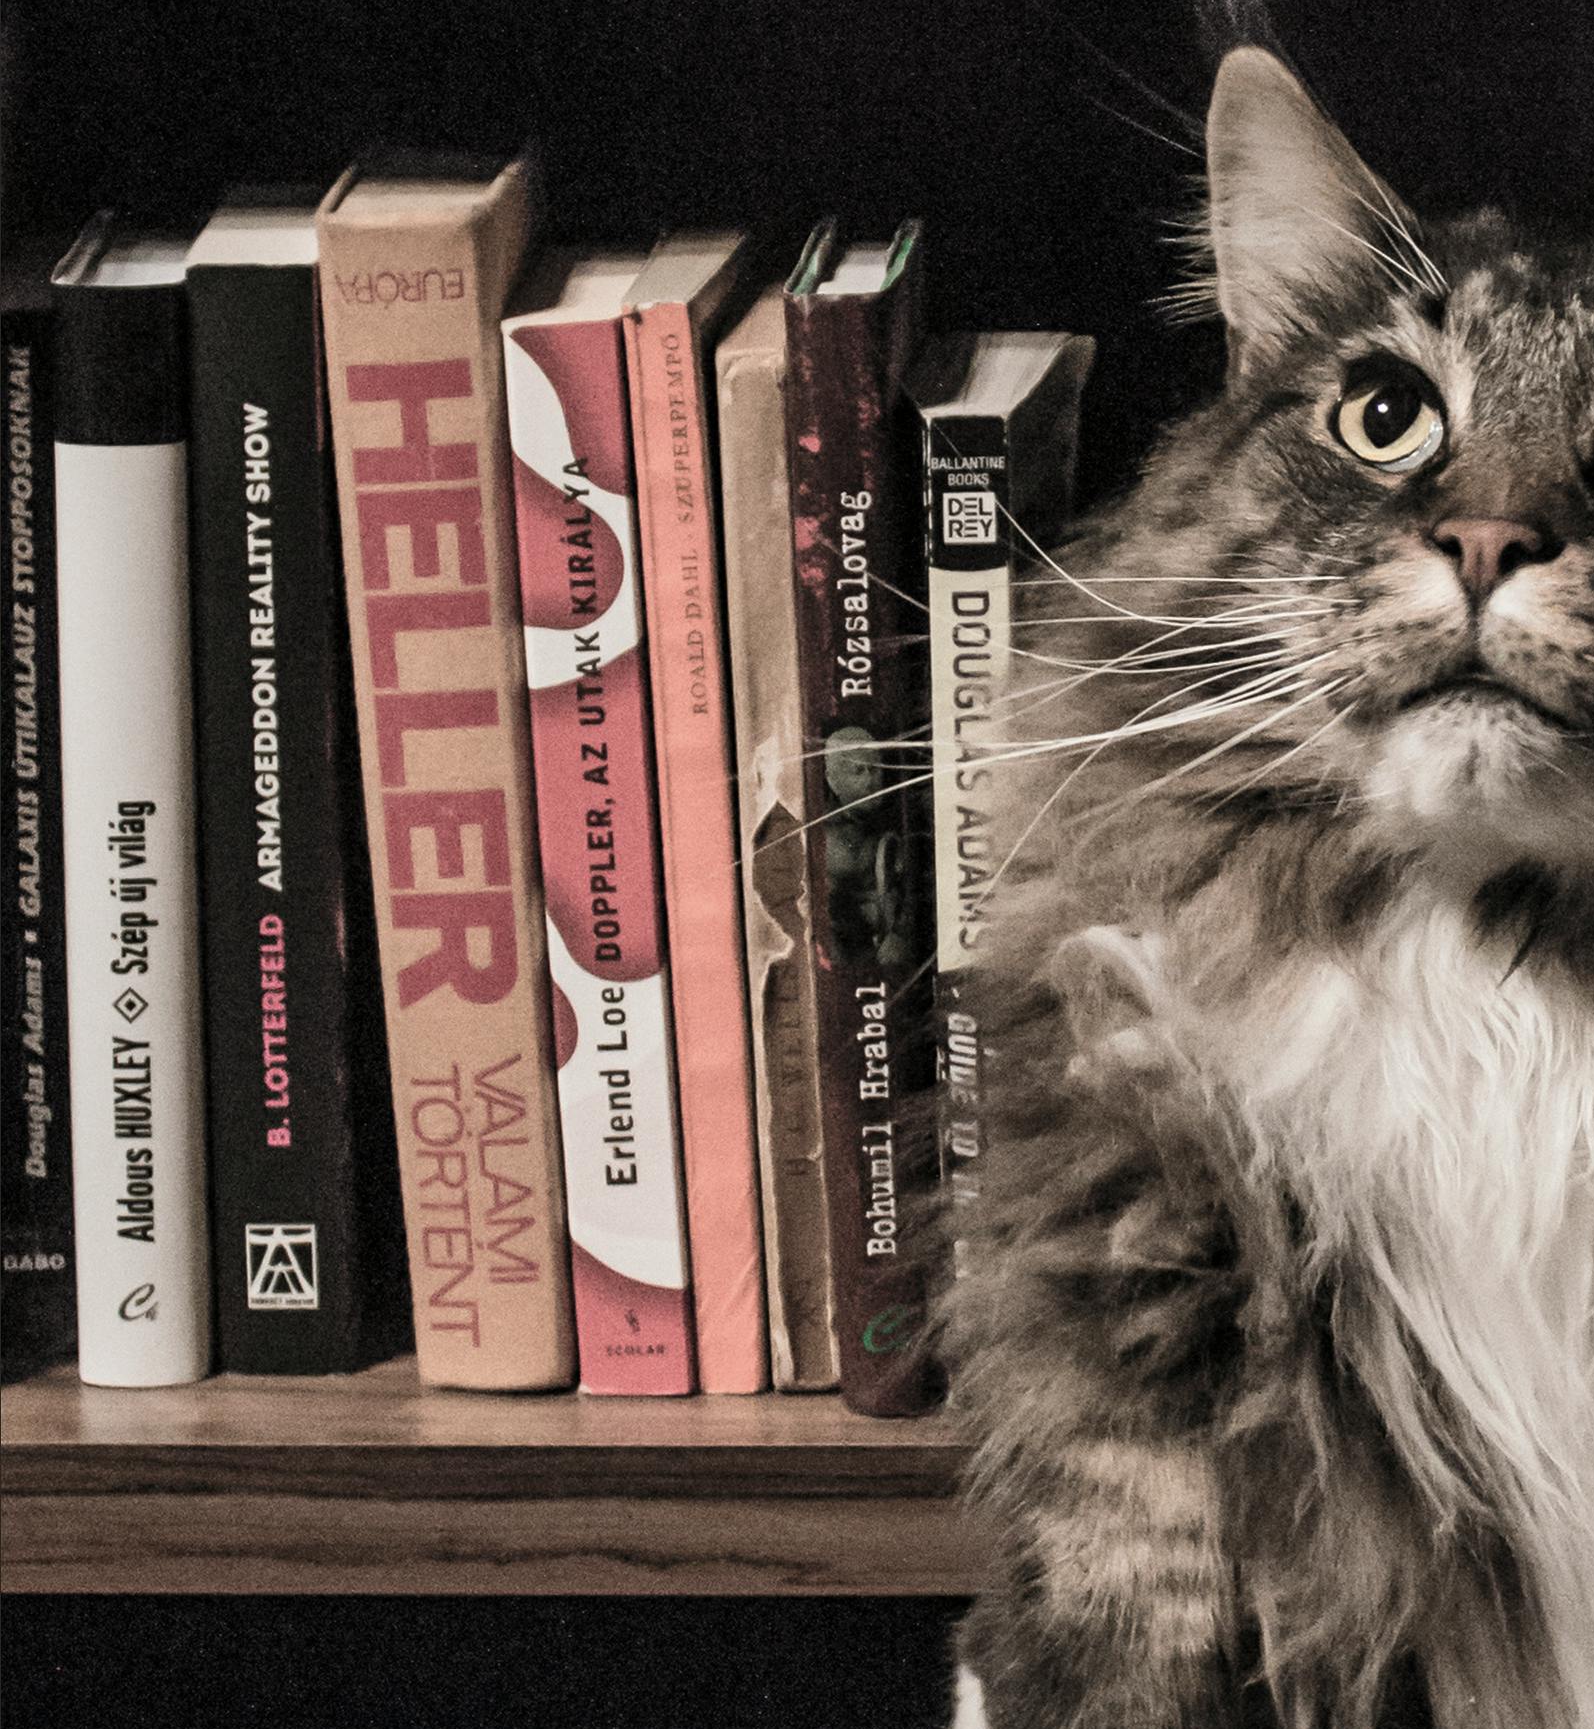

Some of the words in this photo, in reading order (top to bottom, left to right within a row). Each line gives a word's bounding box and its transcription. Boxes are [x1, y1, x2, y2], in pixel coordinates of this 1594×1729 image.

[334, 266, 467, 306] EURÓPA
[5, 346, 37, 596] STOPPOSOKNAK
[242, 402, 272, 502] SHOW
[928, 453, 1007, 471] BALLANTINE
[946, 471, 991, 487] BOOKS
[558, 456, 604, 617] KIRÁLYA
[945, 493, 991, 517] DEL
[945, 518, 991, 541] REY
[246, 511, 276, 648] REALITY
[680, 550, 705, 621] DAHL
[835, 489, 873, 698] Rózsalovag
[345, 355, 524, 1012] HELLER
[572, 631, 610, 728] UTAK
[686, 625, 710, 717] ROALD
[950, 588, 991, 792] DOUGLAS
[252, 656, 283, 892] ARMAGEDDON
[579, 739, 613, 787] AZ
[15, 789, 42, 918] GALAXIS
[106, 800, 157, 873] világ
[584, 795, 622, 961] DOPPLER,
[956, 802, 996, 952] ADAMS
[109, 876, 158, 903] új
[108, 909, 160, 974] Szép
[22, 956, 47, 1057] Adams
[257, 912, 291, 1110] LOTTERFELD
[595, 986, 628, 1052] Loe
[854, 980, 892, 1100] Hrabal
[25, 1063, 54, 1179] Douglas
[111, 1035, 152, 1140] HUXLEY
[266, 1114, 292, 1149] B.
[597, 1067, 639, 1187] Erlend
[115, 1147, 157, 1243] Aldous
[473, 1051, 541, 1286] VALAMI
[861, 1119, 899, 1256] Bohumil
